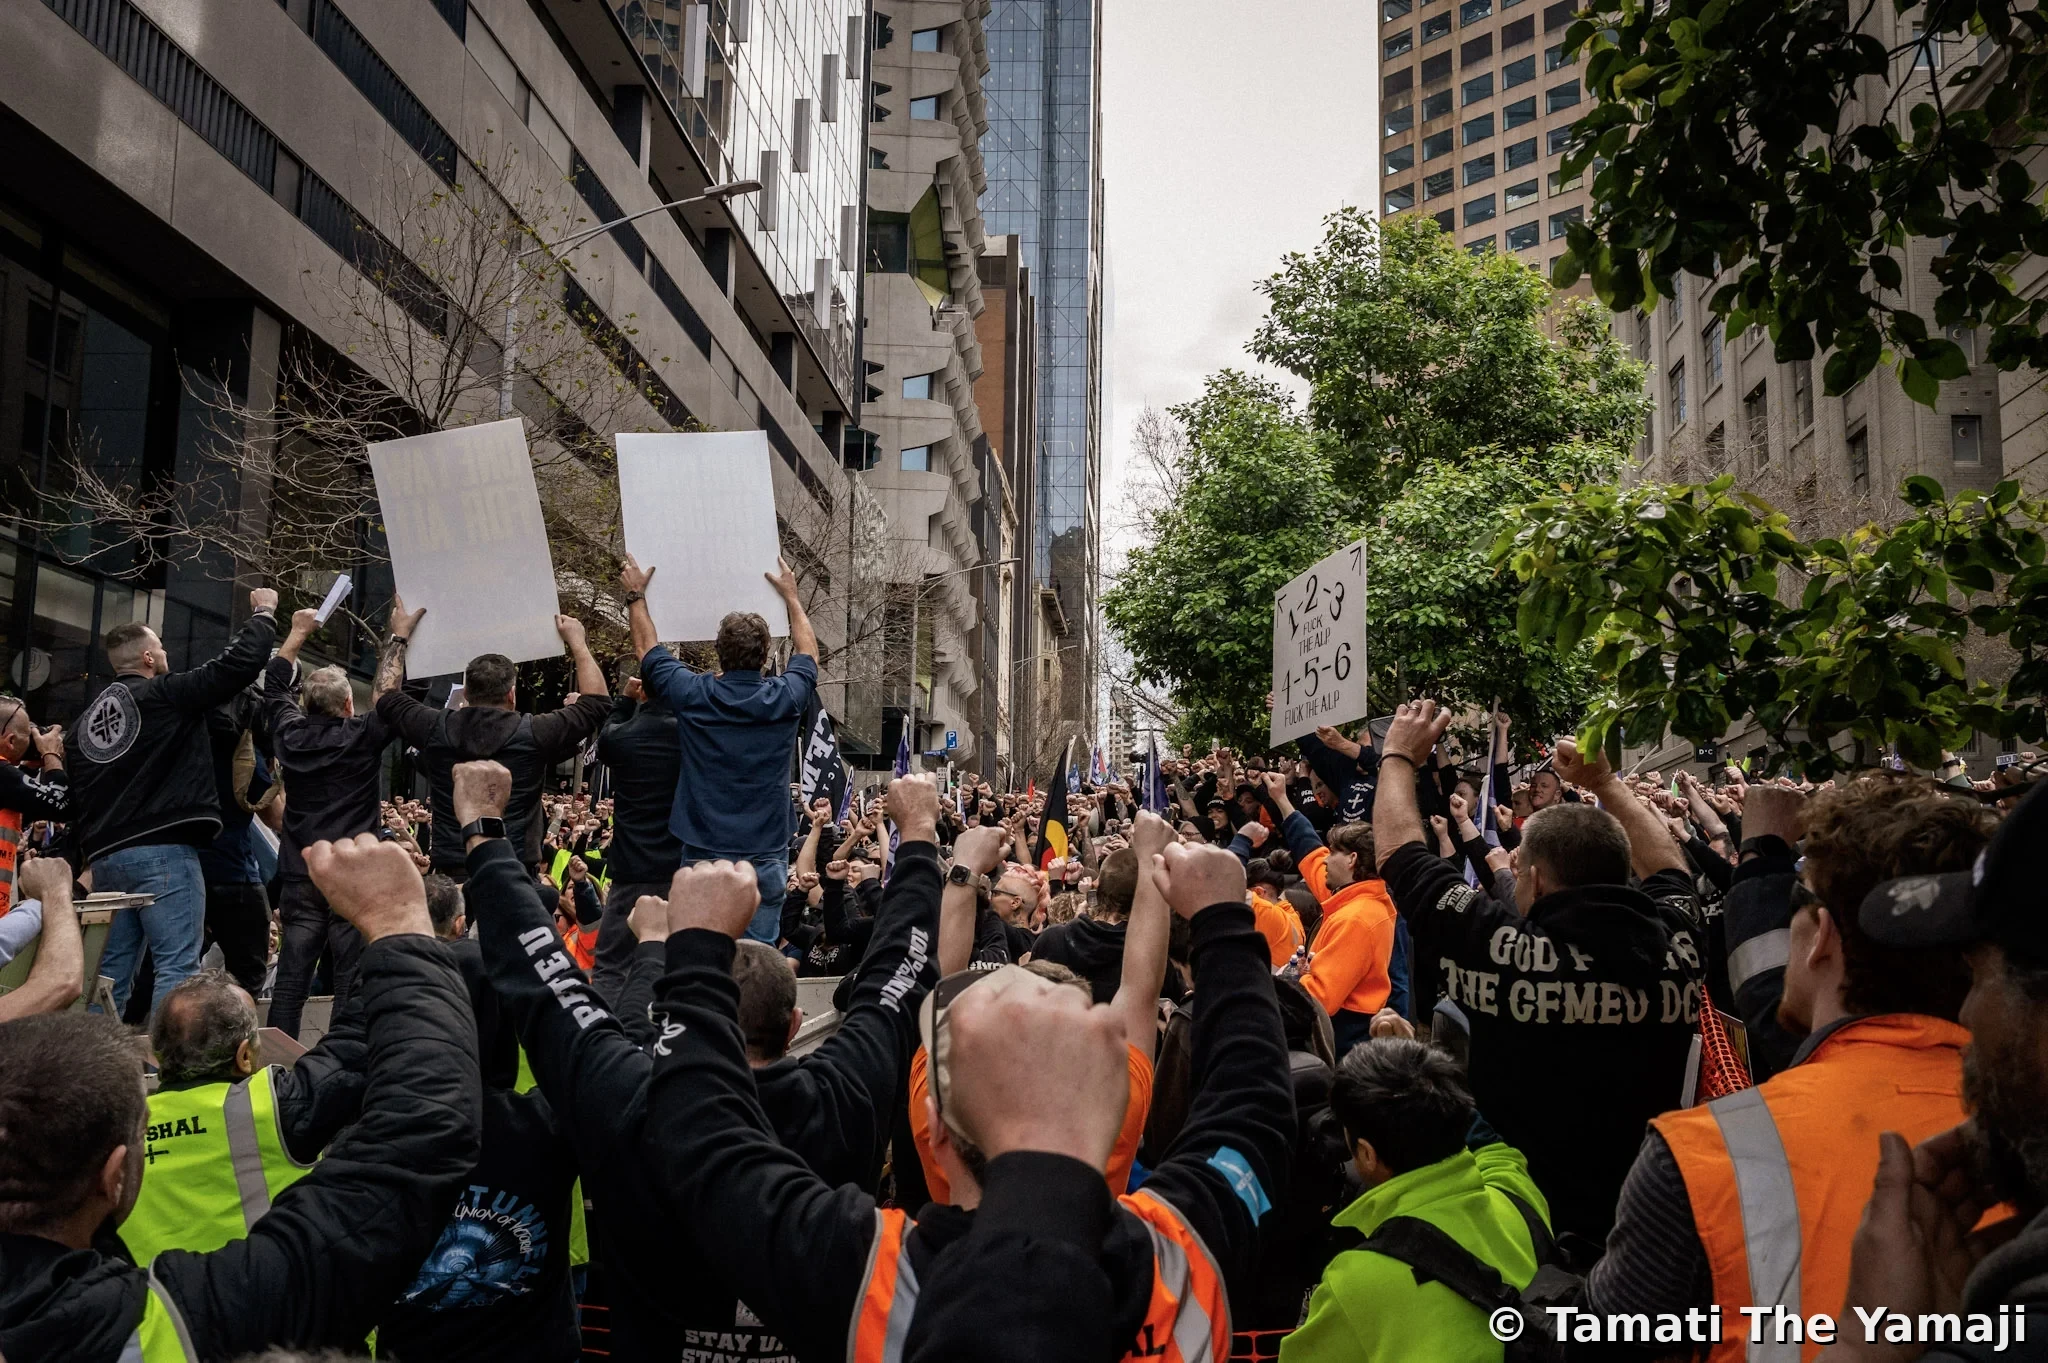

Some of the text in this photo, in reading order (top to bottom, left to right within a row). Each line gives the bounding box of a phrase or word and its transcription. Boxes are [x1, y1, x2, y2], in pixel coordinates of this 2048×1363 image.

[1303, 614, 1323, 636] FUCK
[1298, 636, 1314, 657] THE
[1281, 642, 1351, 706] 4-5-6
[1284, 703, 1304, 728] FUCK
[1305, 697, 1319, 719] THE
[1489, 925, 1560, 973] GOD
[1440, 956, 1500, 1017] THE
[1508, 979, 1650, 1025] CFMEU
[454, 1204, 498, 1222] UNION
[496, 1214, 517, 1228] OF
[684, 1329, 753, 1353] STAY
